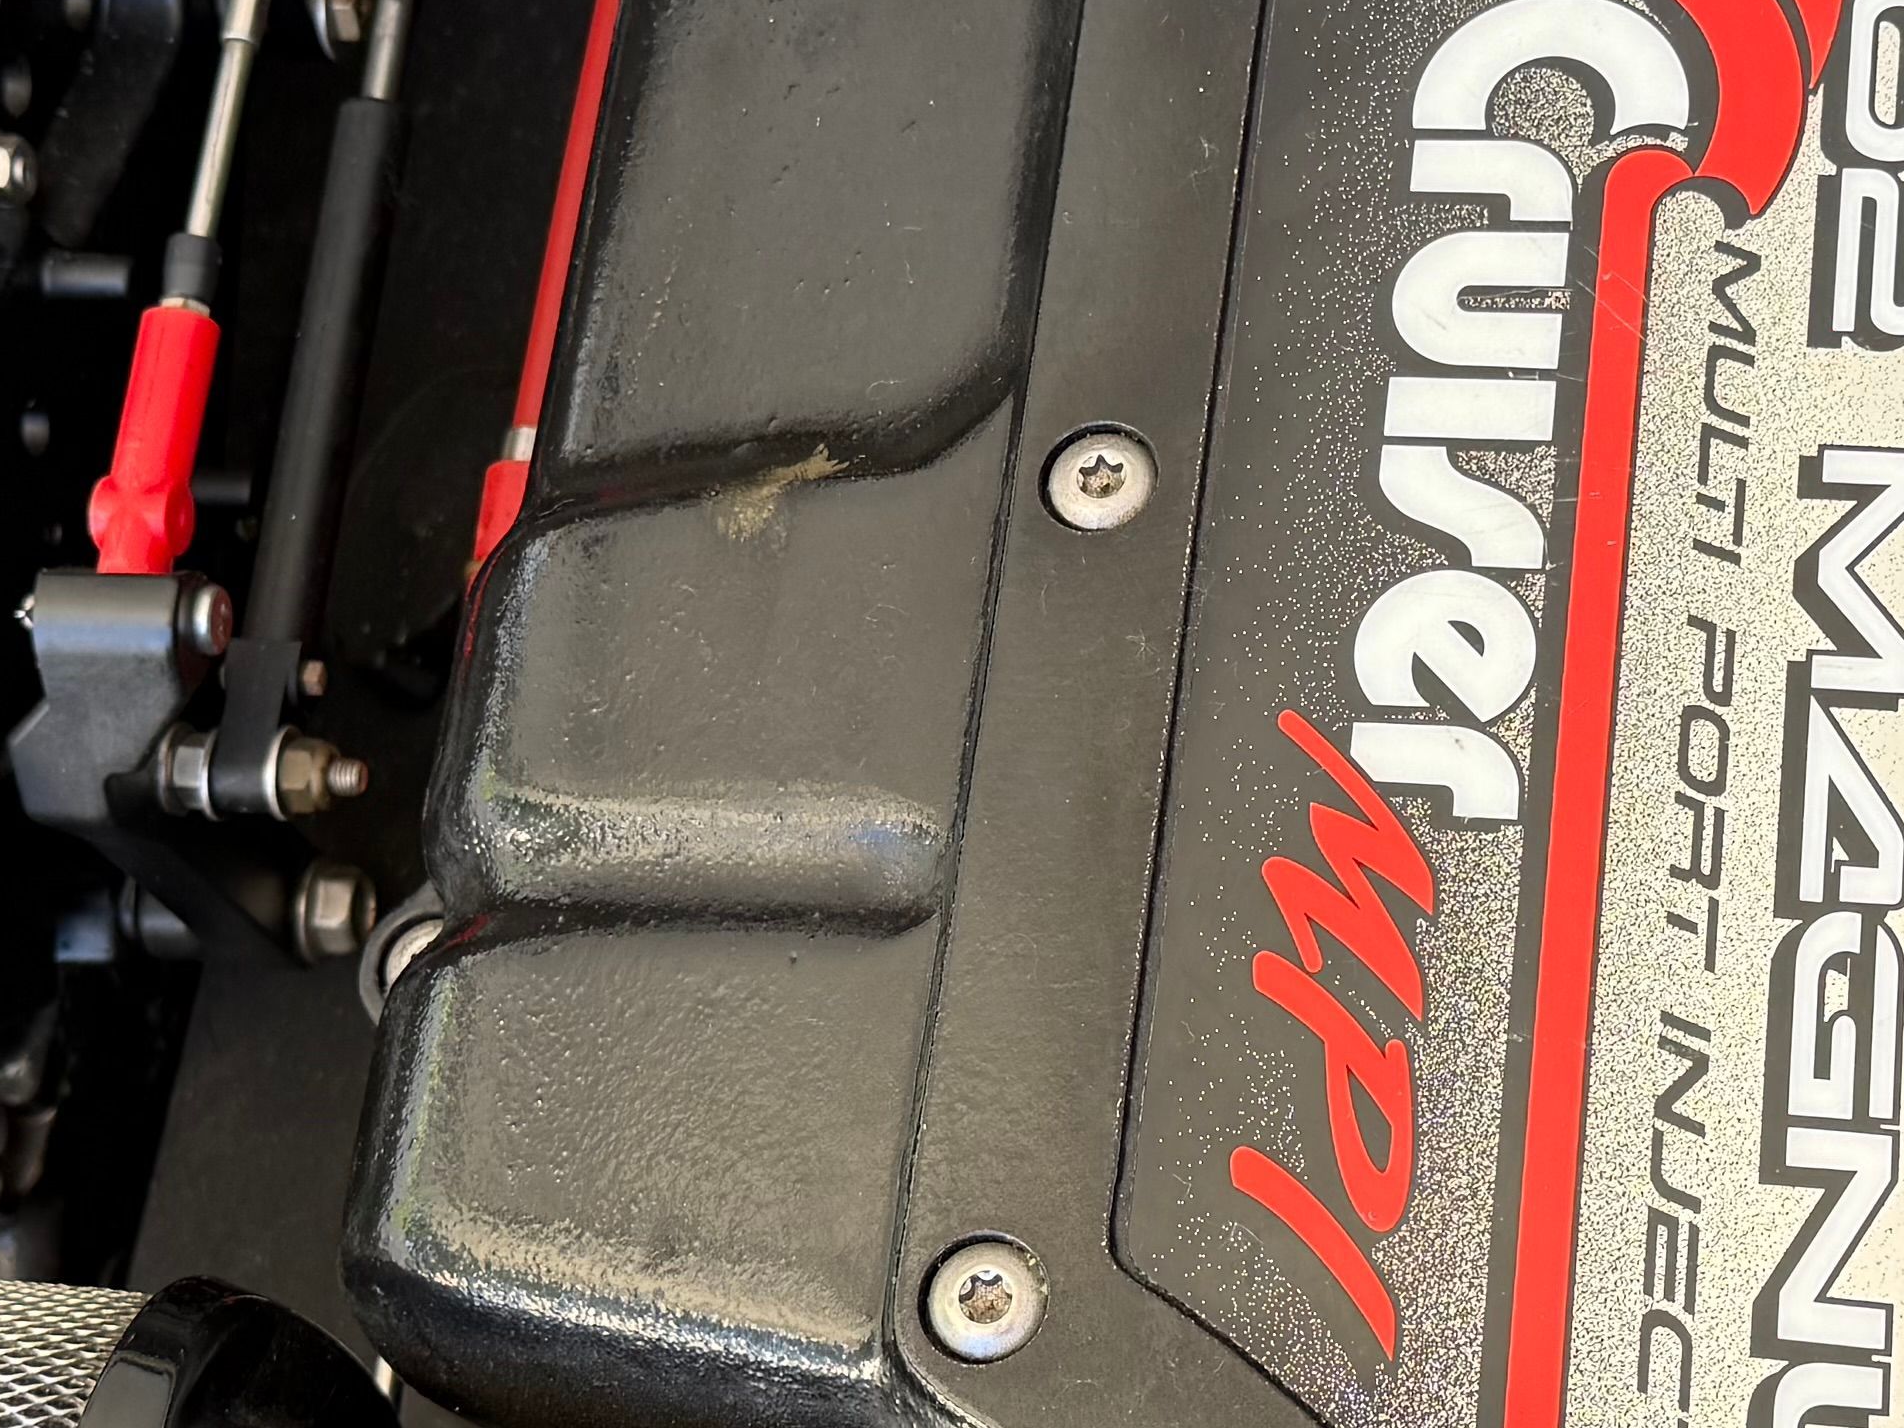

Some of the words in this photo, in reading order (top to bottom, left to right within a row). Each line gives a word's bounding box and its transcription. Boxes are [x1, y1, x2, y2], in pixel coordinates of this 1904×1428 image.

[1693, 240, 1763, 565] MULTI
[1658, 614, 1737, 972] PORT
[1229, 708, 1434, 1362] MPI
